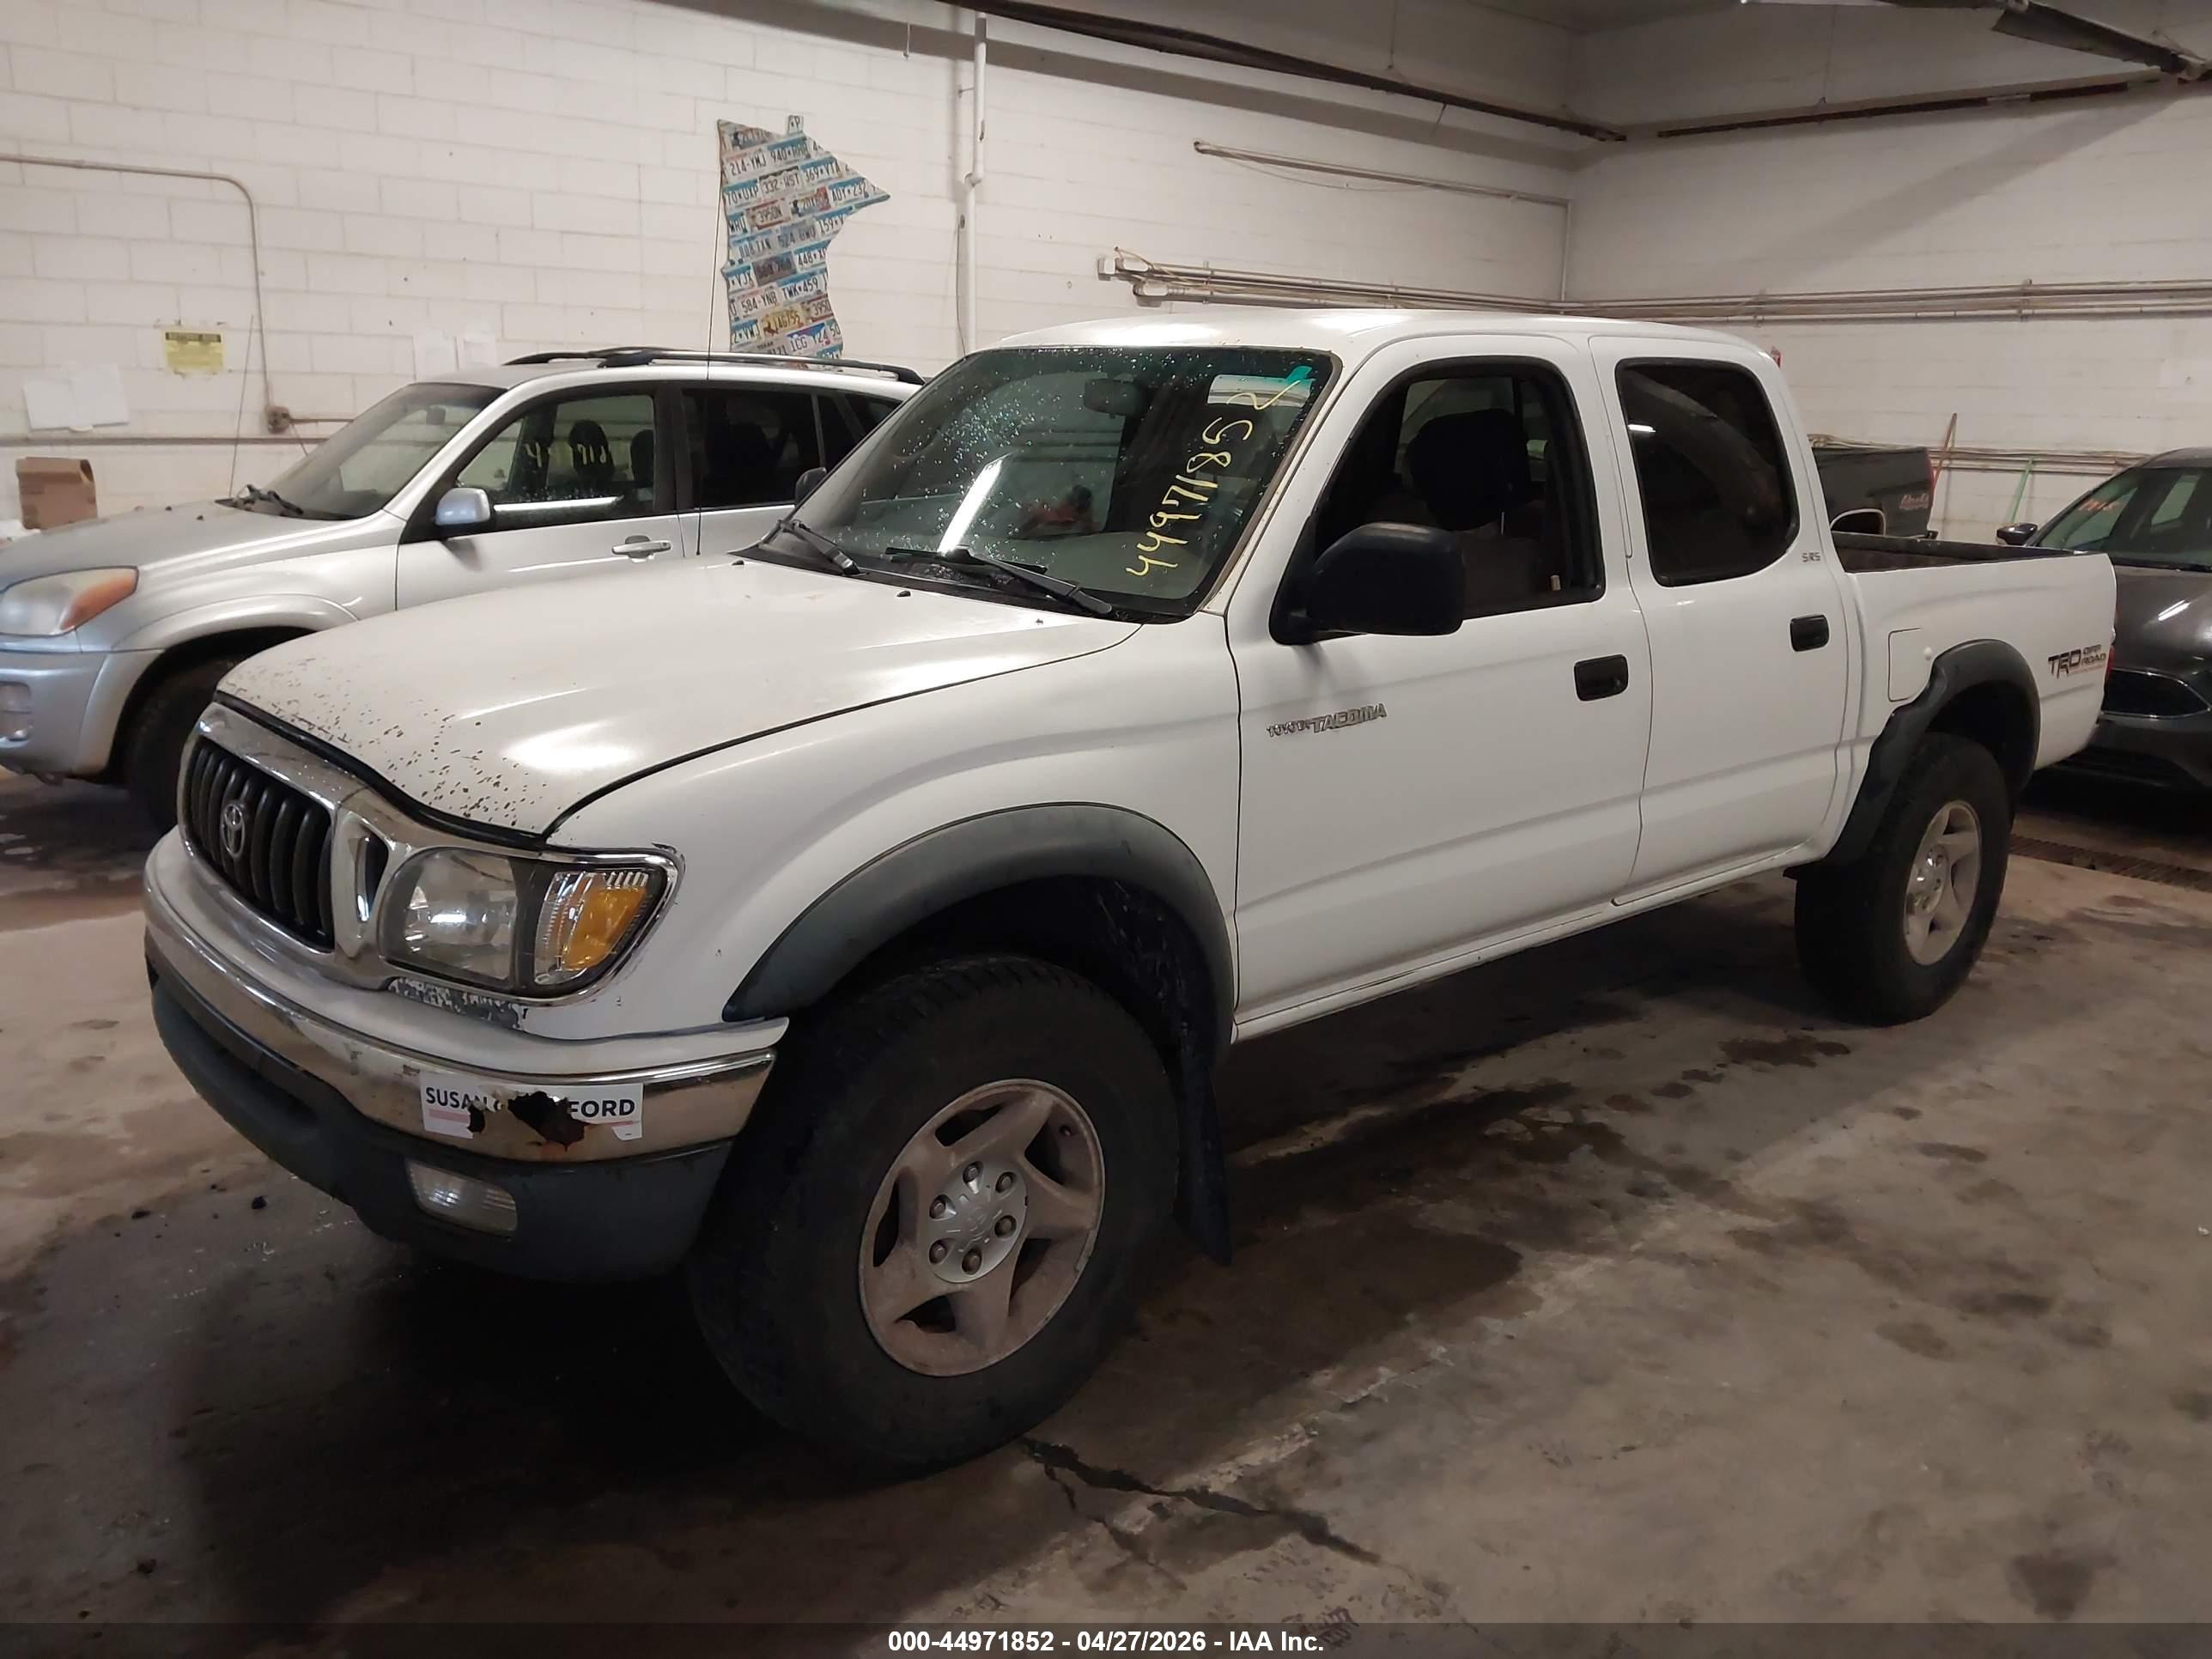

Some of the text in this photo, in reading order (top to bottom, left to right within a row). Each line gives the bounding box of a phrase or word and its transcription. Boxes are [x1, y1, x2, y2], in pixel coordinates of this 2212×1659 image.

[1126, 380, 1301, 577] 44971852
[2048, 649, 2081, 678] TRD
[1310, 703, 1387, 733] TACOMA
